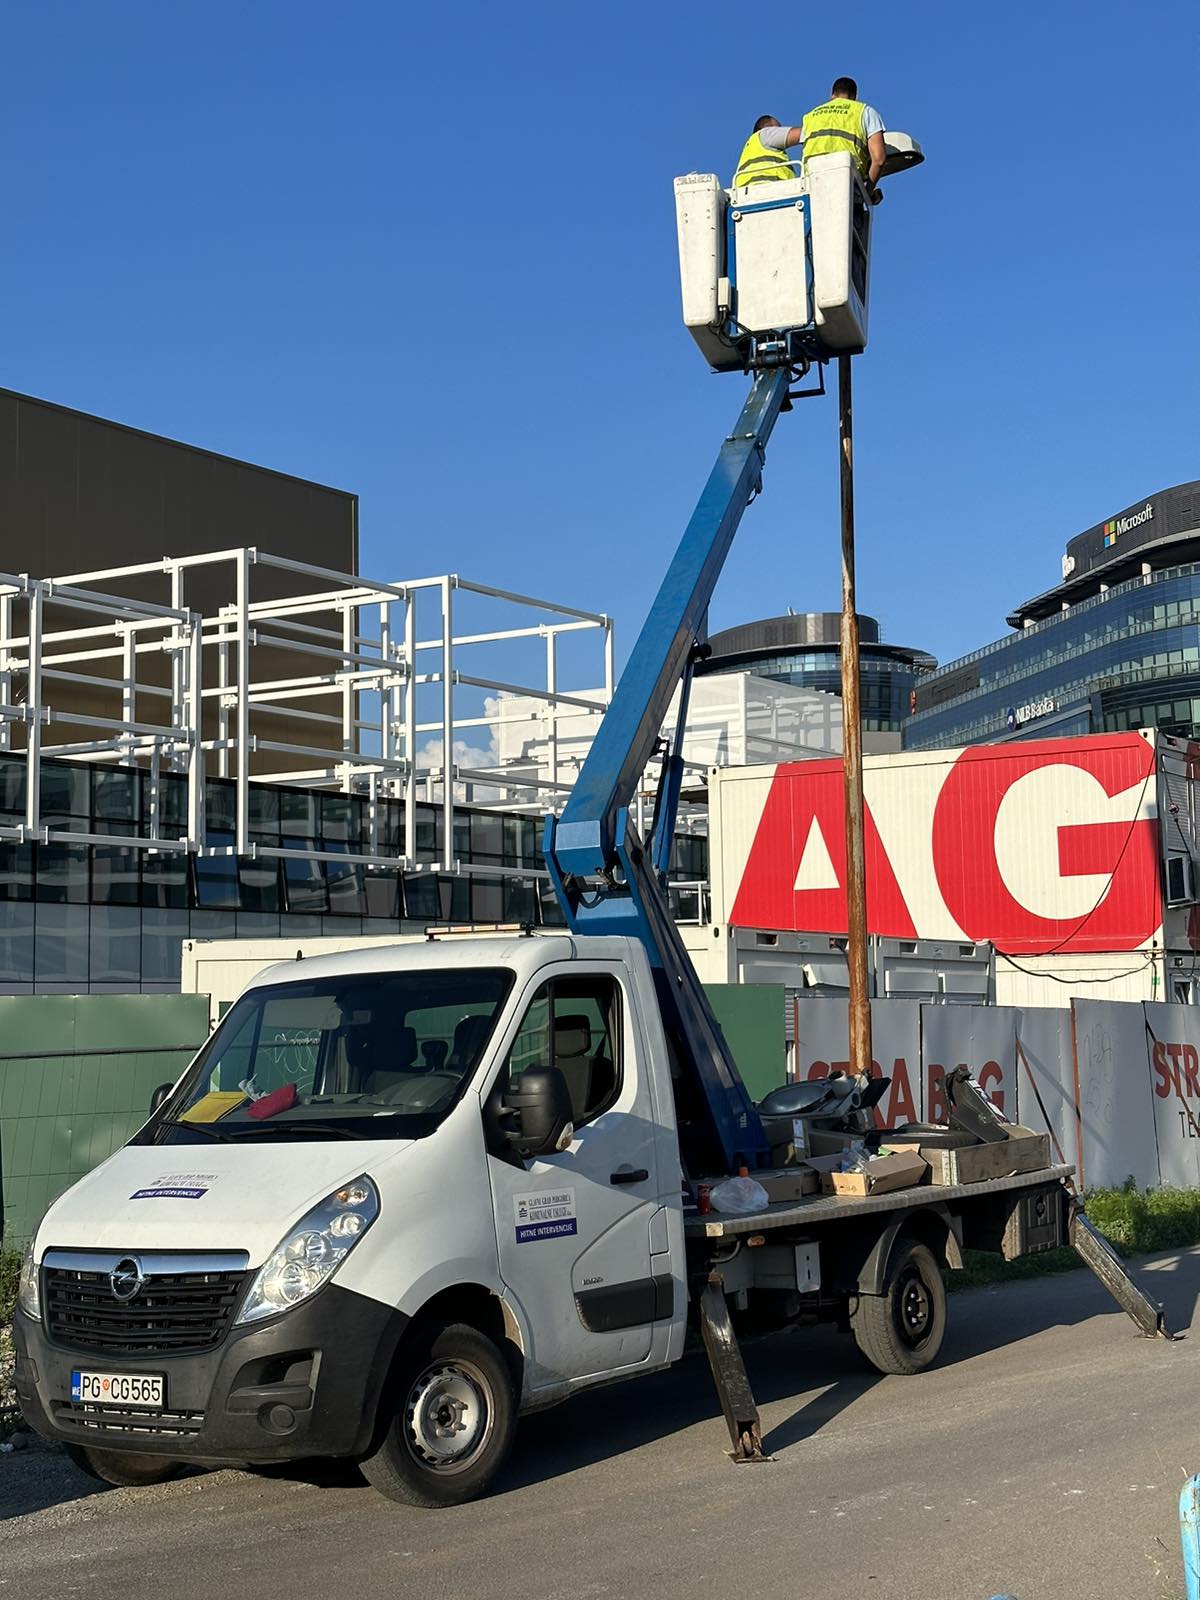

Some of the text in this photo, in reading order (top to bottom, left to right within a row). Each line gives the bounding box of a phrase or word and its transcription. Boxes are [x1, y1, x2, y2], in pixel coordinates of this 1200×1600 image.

[1116, 503, 1153, 536] Microsoft
[1016, 697, 1054, 724] NLB Banka
[1179, 1111, 1200, 1138] TE
[520, 1223, 573, 1238] HITNE INTERVENCIJE
[82, 1375, 161, 1401] PG CG565
